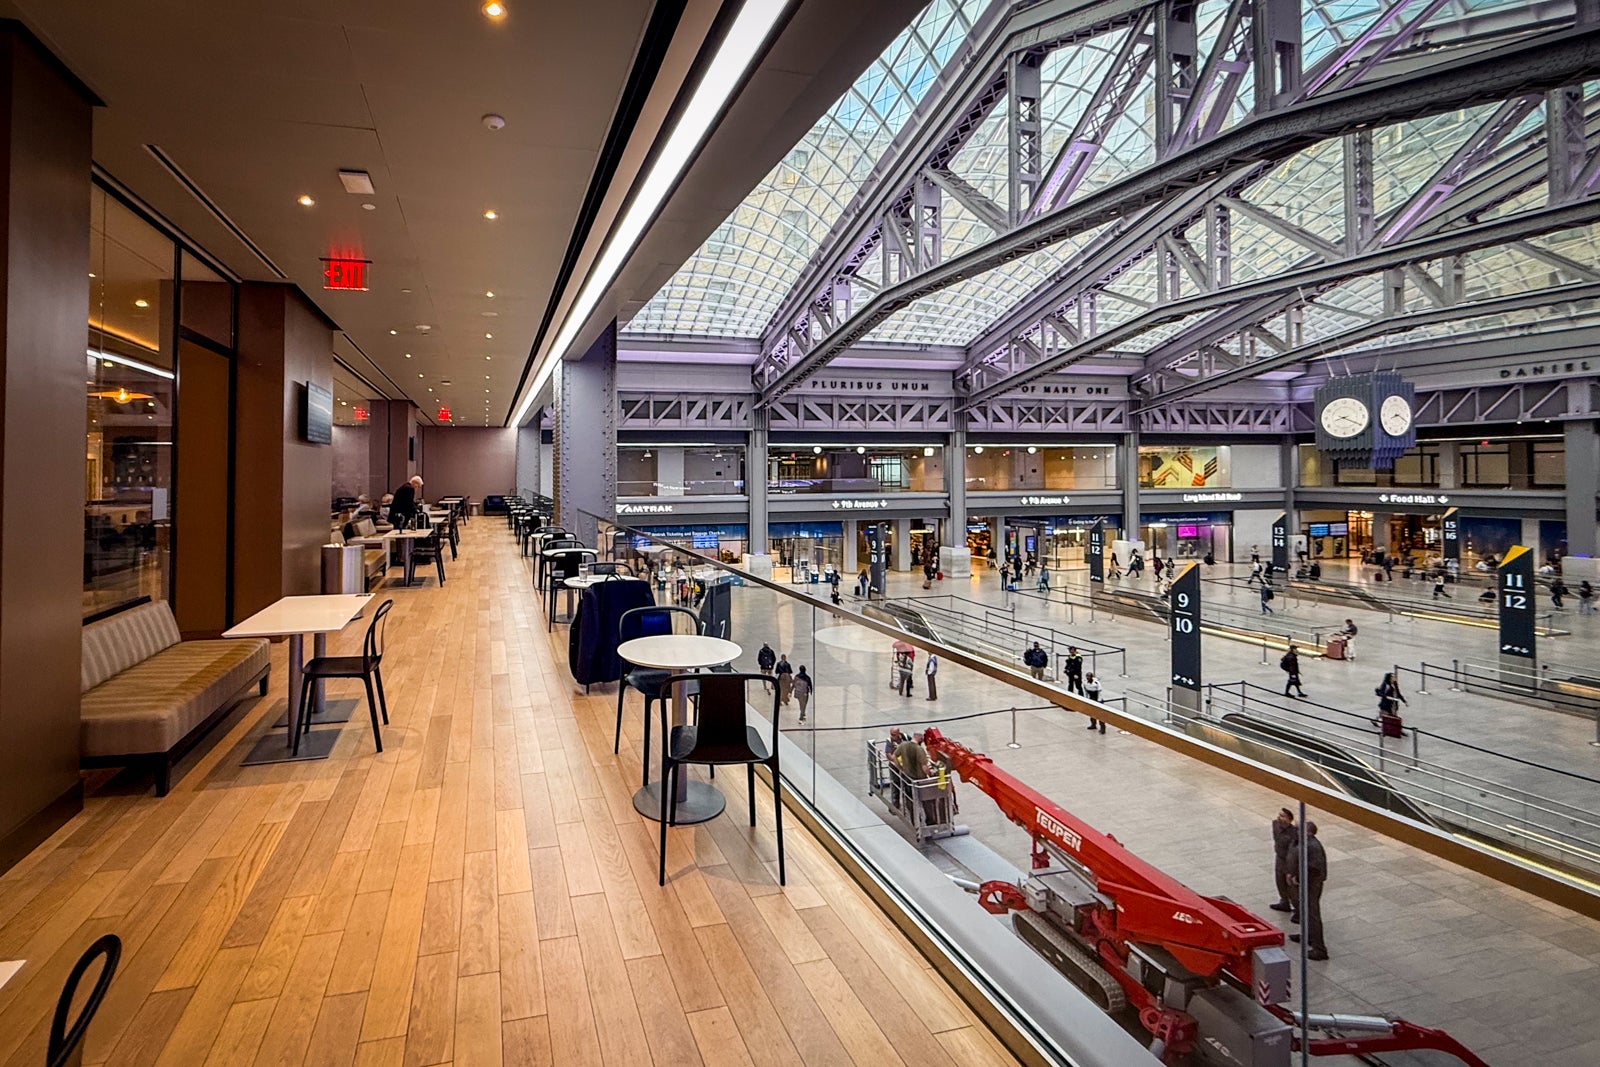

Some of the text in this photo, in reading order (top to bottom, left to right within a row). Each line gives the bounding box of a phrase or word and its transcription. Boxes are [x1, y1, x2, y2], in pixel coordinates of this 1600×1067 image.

[329, 261, 363, 288] EXIT
[1500, 361, 1590, 378] DANIEL
[811, 381, 928, 391] PLURIBUS UNUM
[1043, 386, 1076, 394] MANY
[1086, 387, 1109, 395] ONE
[1390, 495, 1435, 504] Food Hall
[625, 505, 673, 513] AMTRAK
[1446, 521, 1456, 529] 15
[1275, 527, 1284, 535] 13
[1092, 533, 1099, 542] 11
[1446, 532, 1456, 540] 16
[872, 541, 877, 549] 9
[1275, 539, 1284, 547] 14
[1091, 546, 1100, 554] 12
[1504, 573, 1523, 588] 11
[1178, 593, 1188, 608] 9
[1505, 595, 1526, 609] 12
[720, 620, 725, 638] 7
[1175, 617, 1192, 633] 10
[1035, 806, 1082, 852] TEUPEN
